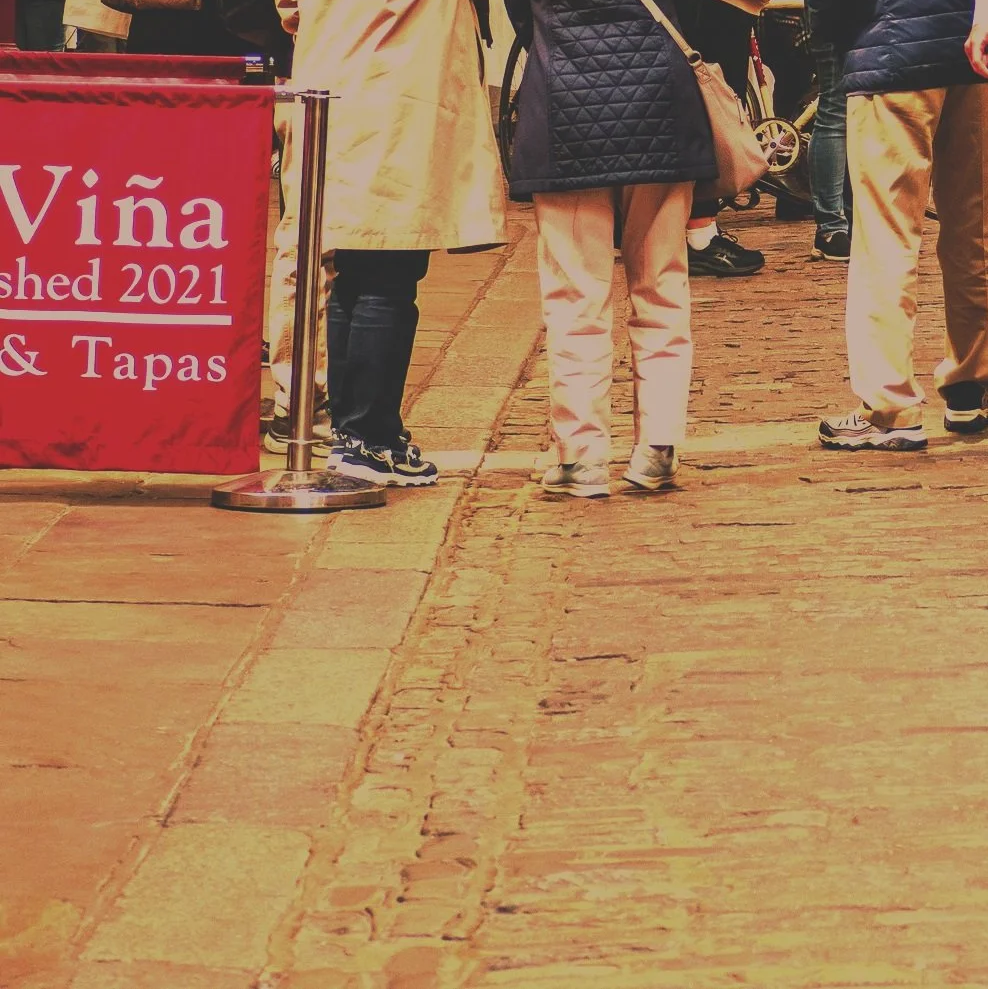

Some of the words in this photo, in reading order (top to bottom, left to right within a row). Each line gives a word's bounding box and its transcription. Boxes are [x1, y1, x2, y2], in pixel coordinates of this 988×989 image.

[0, 164, 229, 250] Viña
[0, 257, 102, 302] shed
[119, 263, 228, 305] 2021
[0, 333, 48, 377] &
[71, 335, 228, 391] Tapas
